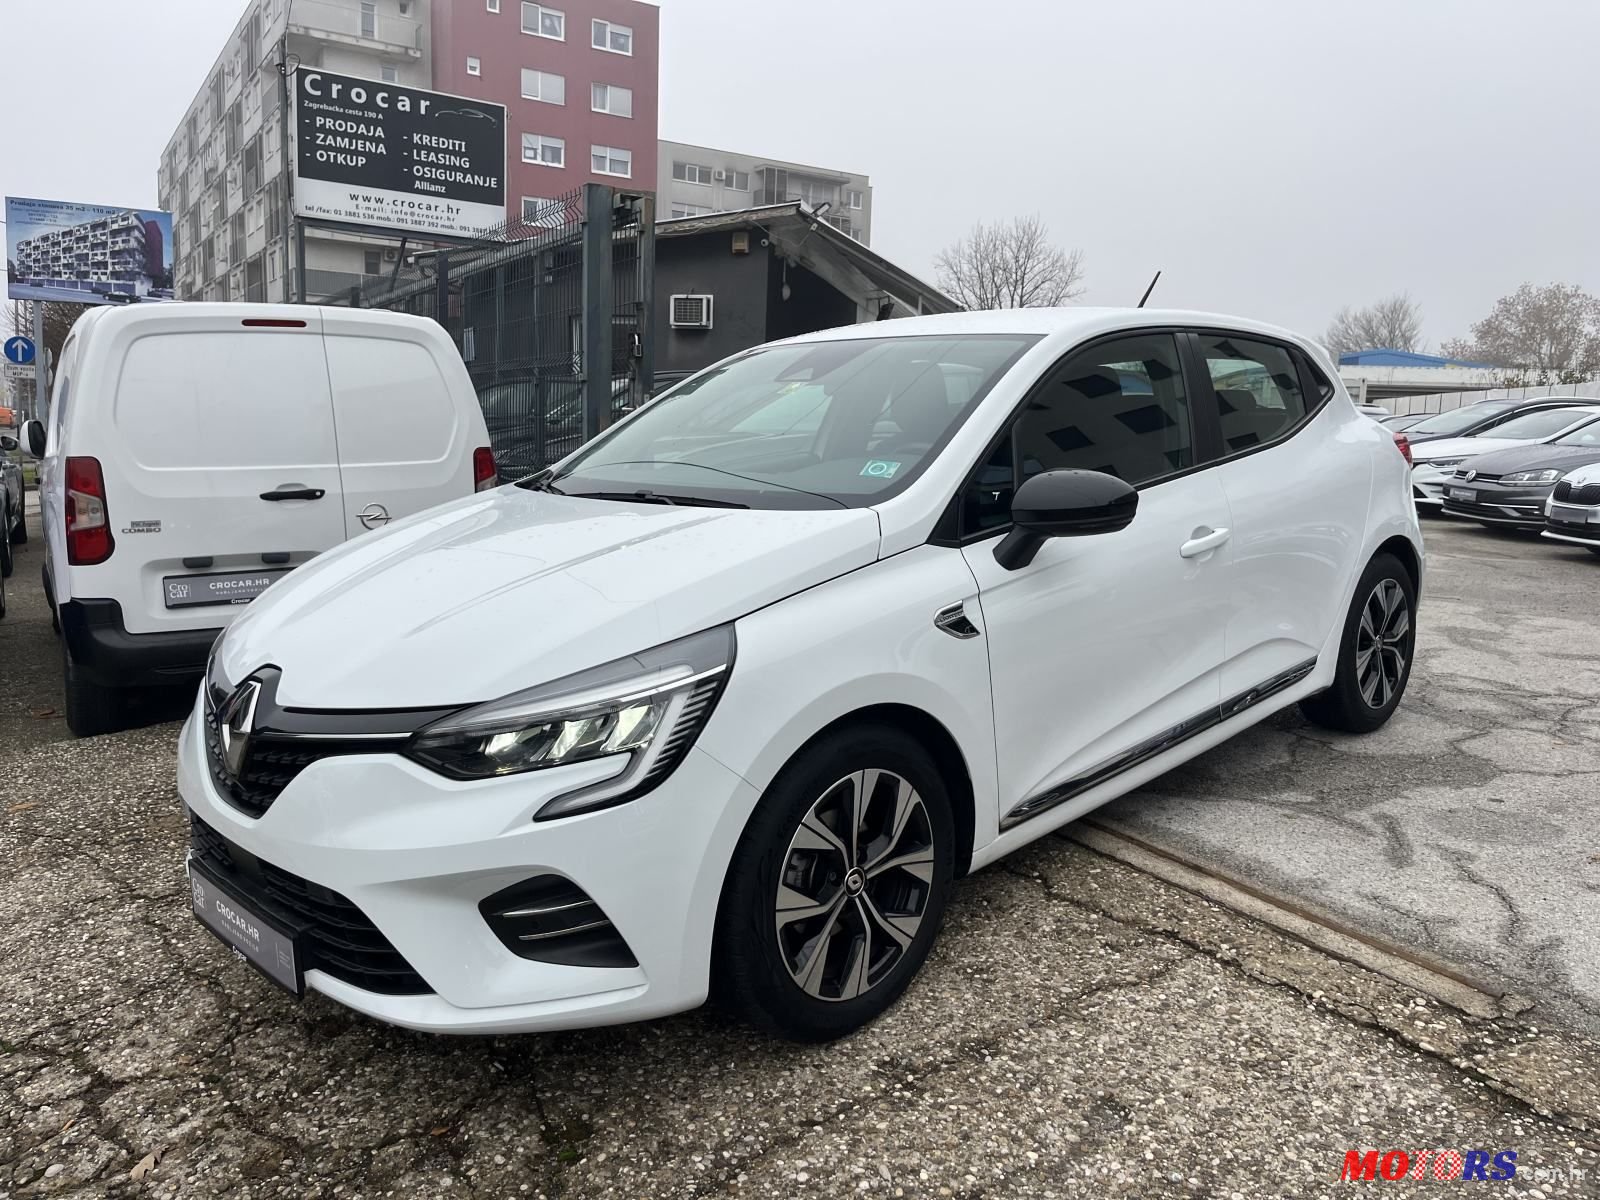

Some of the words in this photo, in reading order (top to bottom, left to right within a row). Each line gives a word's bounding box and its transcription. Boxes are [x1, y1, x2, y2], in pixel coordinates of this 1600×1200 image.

[304, 74, 430, 114] Crocar
[345, 108, 362, 116] cesta
[364, 110, 376, 118] 190
[316, 116, 385, 138] PRODAJA
[316, 134, 386, 155] ZAMJENA
[413, 133, 466, 152] KREDITI
[316, 150, 366, 167] OTKUP
[413, 149, 470, 168] LEASING
[413, 166, 498, 188] OSIGURANJE
[414, 180, 446, 193] Allianz
[350, 193, 461, 215] www.crocar.hr
[390, 208, 455, 222] info@crocar.hr
[169, 584, 188, 592] Cro
[210, 578, 270, 590] CROCAR.HR
[170, 590, 188, 598] car
[216, 900, 260, 942] CROCAR.HR
